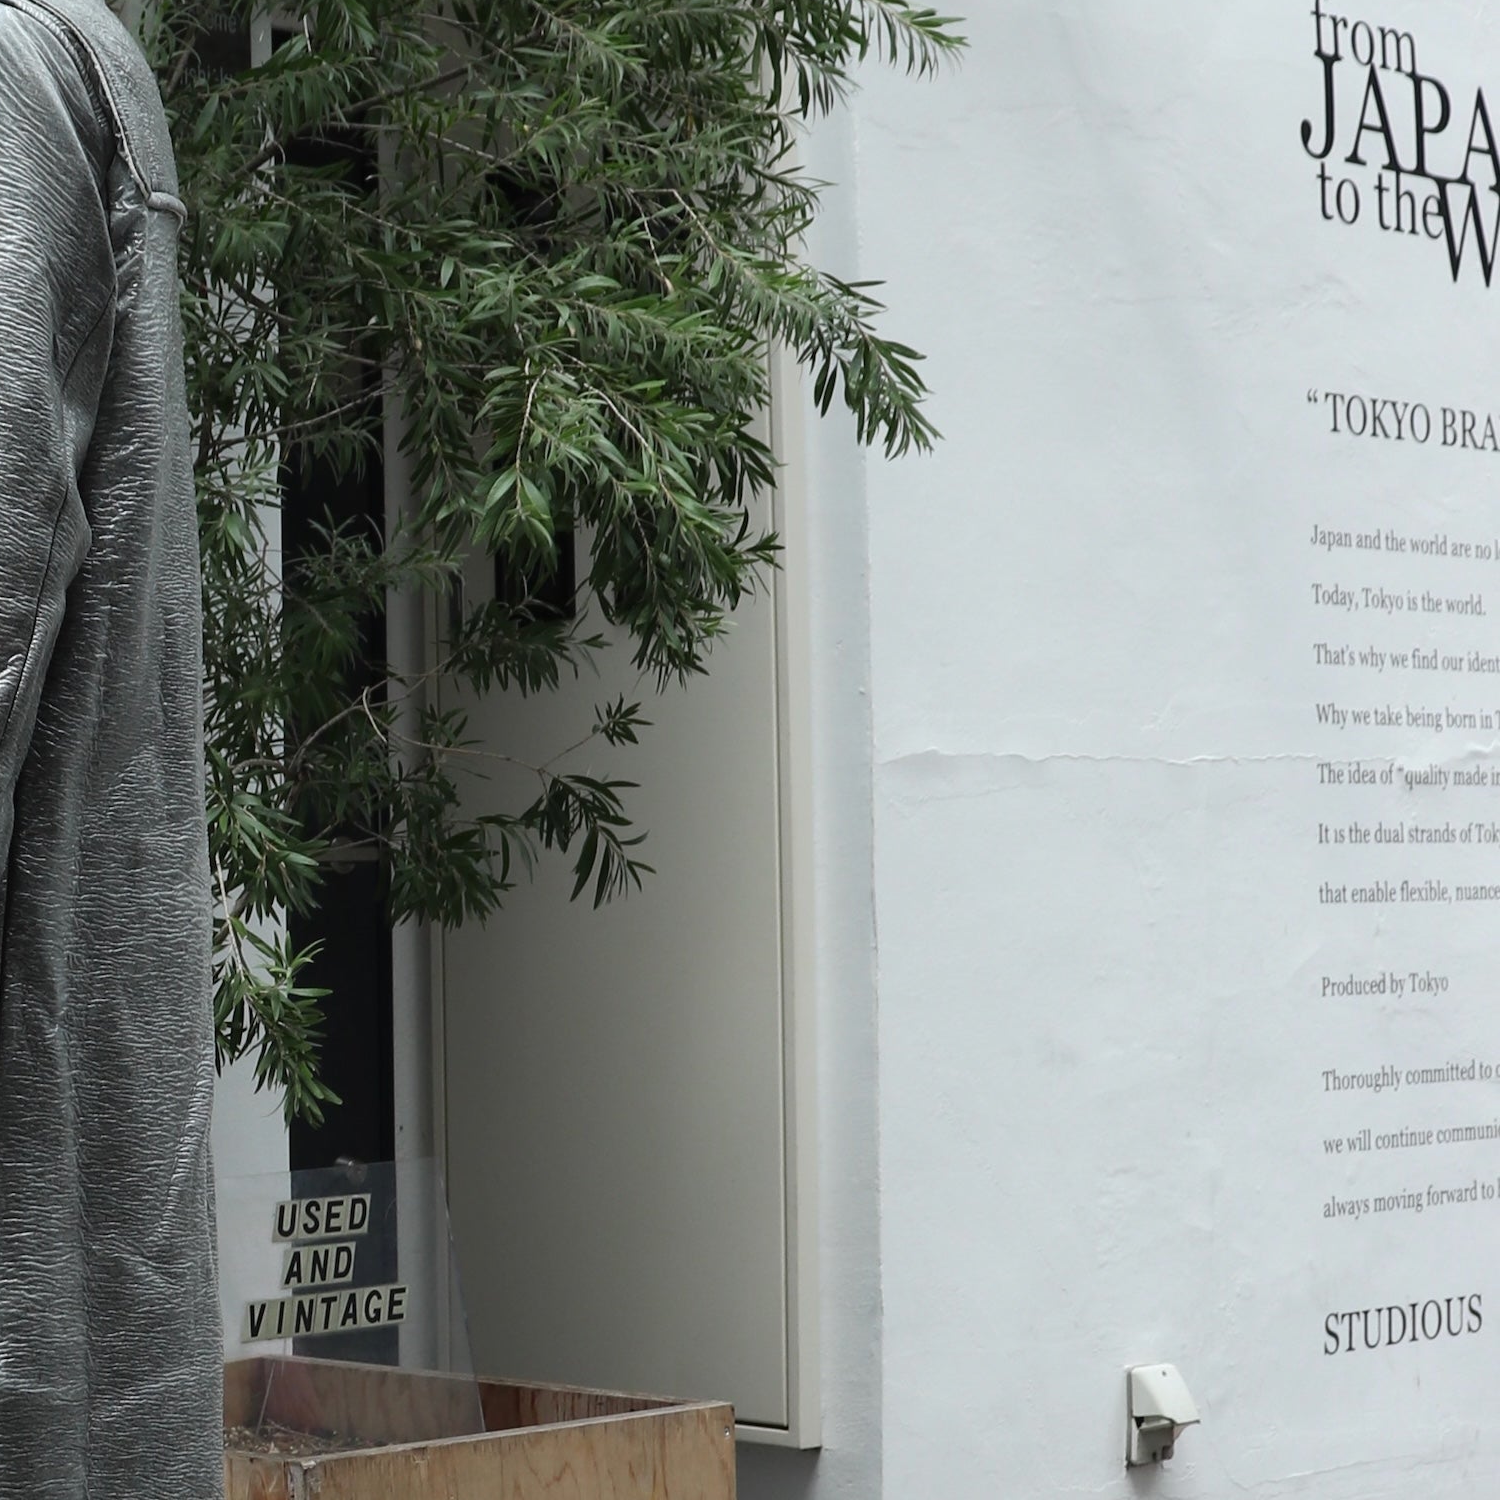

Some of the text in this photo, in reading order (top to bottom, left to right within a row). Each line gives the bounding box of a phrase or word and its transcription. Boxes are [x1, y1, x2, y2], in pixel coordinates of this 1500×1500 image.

[1300, 50, 1500, 196] JAPA
[1316, 162, 1361, 225] to
[1374, 168, 1445, 240] the
[1310, 523, 1353, 552] Japan
[1356, 528, 1381, 551] and
[1385, 529, 1407, 552] the
[1410, 534, 1448, 556] world
[1451, 541, 1472, 558] are
[1475, 543, 1492, 560] no
[1311, 583, 1487, 616] Today, Tokyo is the world.
[1358, 645, 1387, 673] why
[1390, 652, 1409, 669] we
[1411, 648, 1439, 670] find
[1441, 656, 1464, 672] our
[1315, 702, 1349, 730] Why
[1351, 709, 1371, 726] we
[1374, 704, 1403, 727] take
[1405, 705, 1444, 732] being
[1445, 706, 1477, 729] born
[1479, 708, 1493, 730] in
[1317, 762, 1345, 785] The
[1348, 762, 1377, 785] idea
[1380, 763, 1395, 786] of
[1453, 764, 1489, 787] made
[1318, 821, 1500, 848] It is the dual strands of Tok
[1318, 881, 1348, 904] that
[1351, 880, 1397, 903] enable
[1400, 879, 1453, 904] flexible,
[1321, 970, 1450, 999] Produced by Tokyo
[1321, 1064, 1403, 1093] Thoroughly
[1405, 1058, 1476, 1085] committed
[1478, 1061, 1493, 1081] to
[1323, 1118, 1500, 1155] we will continue communi
[277, 1197, 367, 1238] USED
[1323, 1195, 1370, 1220] always
[1373, 1188, 1424, 1213] moving
[1426, 1180, 1478, 1207] forward
[1481, 1182, 1495, 1200] to
[284, 1246, 352, 1286] AND
[249, 1287, 407, 1338] VINTAGE
[1323, 1293, 1483, 1357] STUDIOUS
